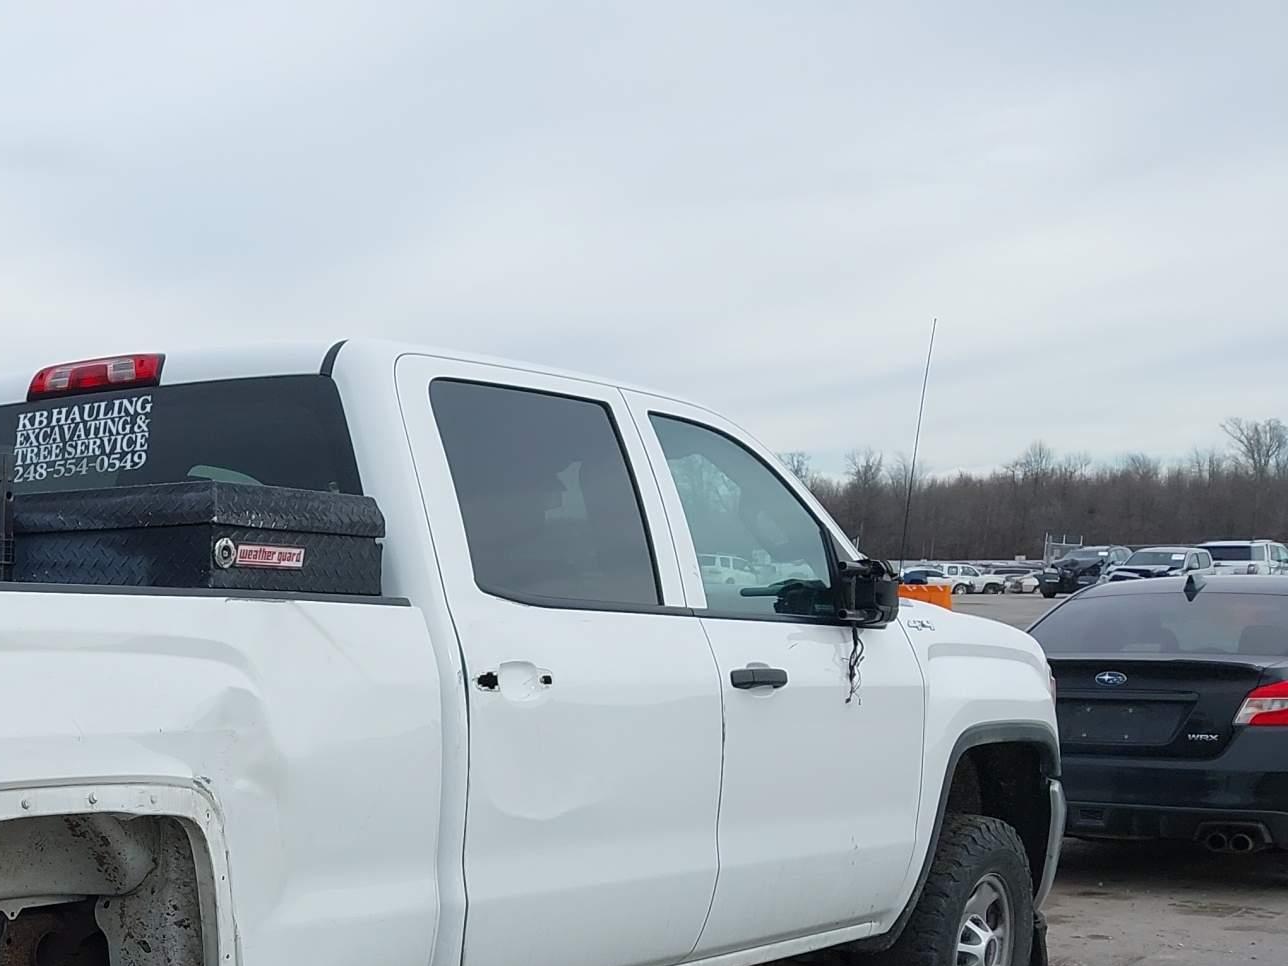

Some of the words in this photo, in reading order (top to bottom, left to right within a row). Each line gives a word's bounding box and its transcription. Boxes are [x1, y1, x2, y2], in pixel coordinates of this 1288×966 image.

[17, 411, 48, 432] KB
[51, 394, 153, 427] HAULING
[15, 416, 132, 449] EXCAVATING
[134, 414, 152, 433] &
[13, 442, 63, 466] TREE
[64, 432, 149, 459] SERVICE
[13, 451, 147, 483] 248-554-0549
[239, 547, 277, 561] weather
[277, 550, 302, 563] guard
[1187, 733, 1220, 741] WRX
